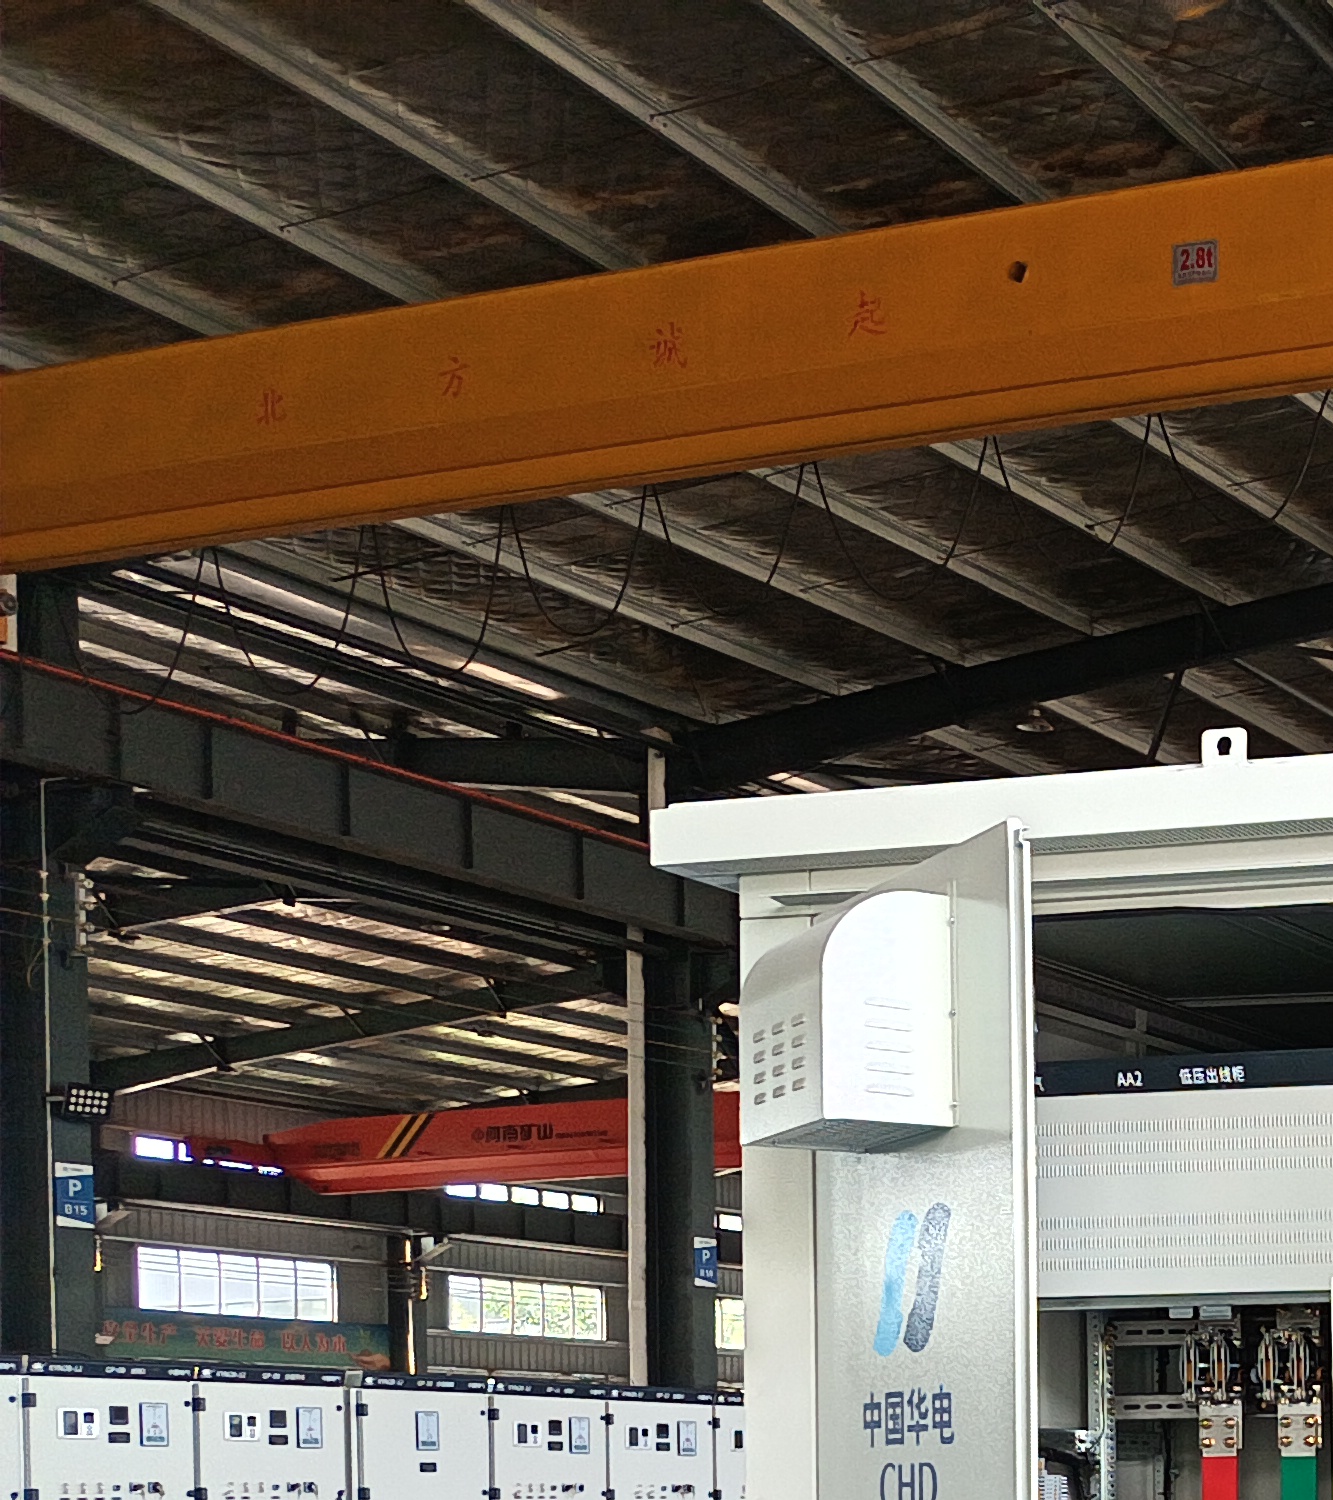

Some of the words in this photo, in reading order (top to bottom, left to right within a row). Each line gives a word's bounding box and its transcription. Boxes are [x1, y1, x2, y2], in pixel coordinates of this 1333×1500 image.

[1180, 246, 1213, 271] 2.8t
[1117, 1070, 1144, 1088] AA2
[68, 1179, 83, 1197] P
[702, 1249, 711, 1265] P
[863, 1384, 956, 1448] 中国华电
